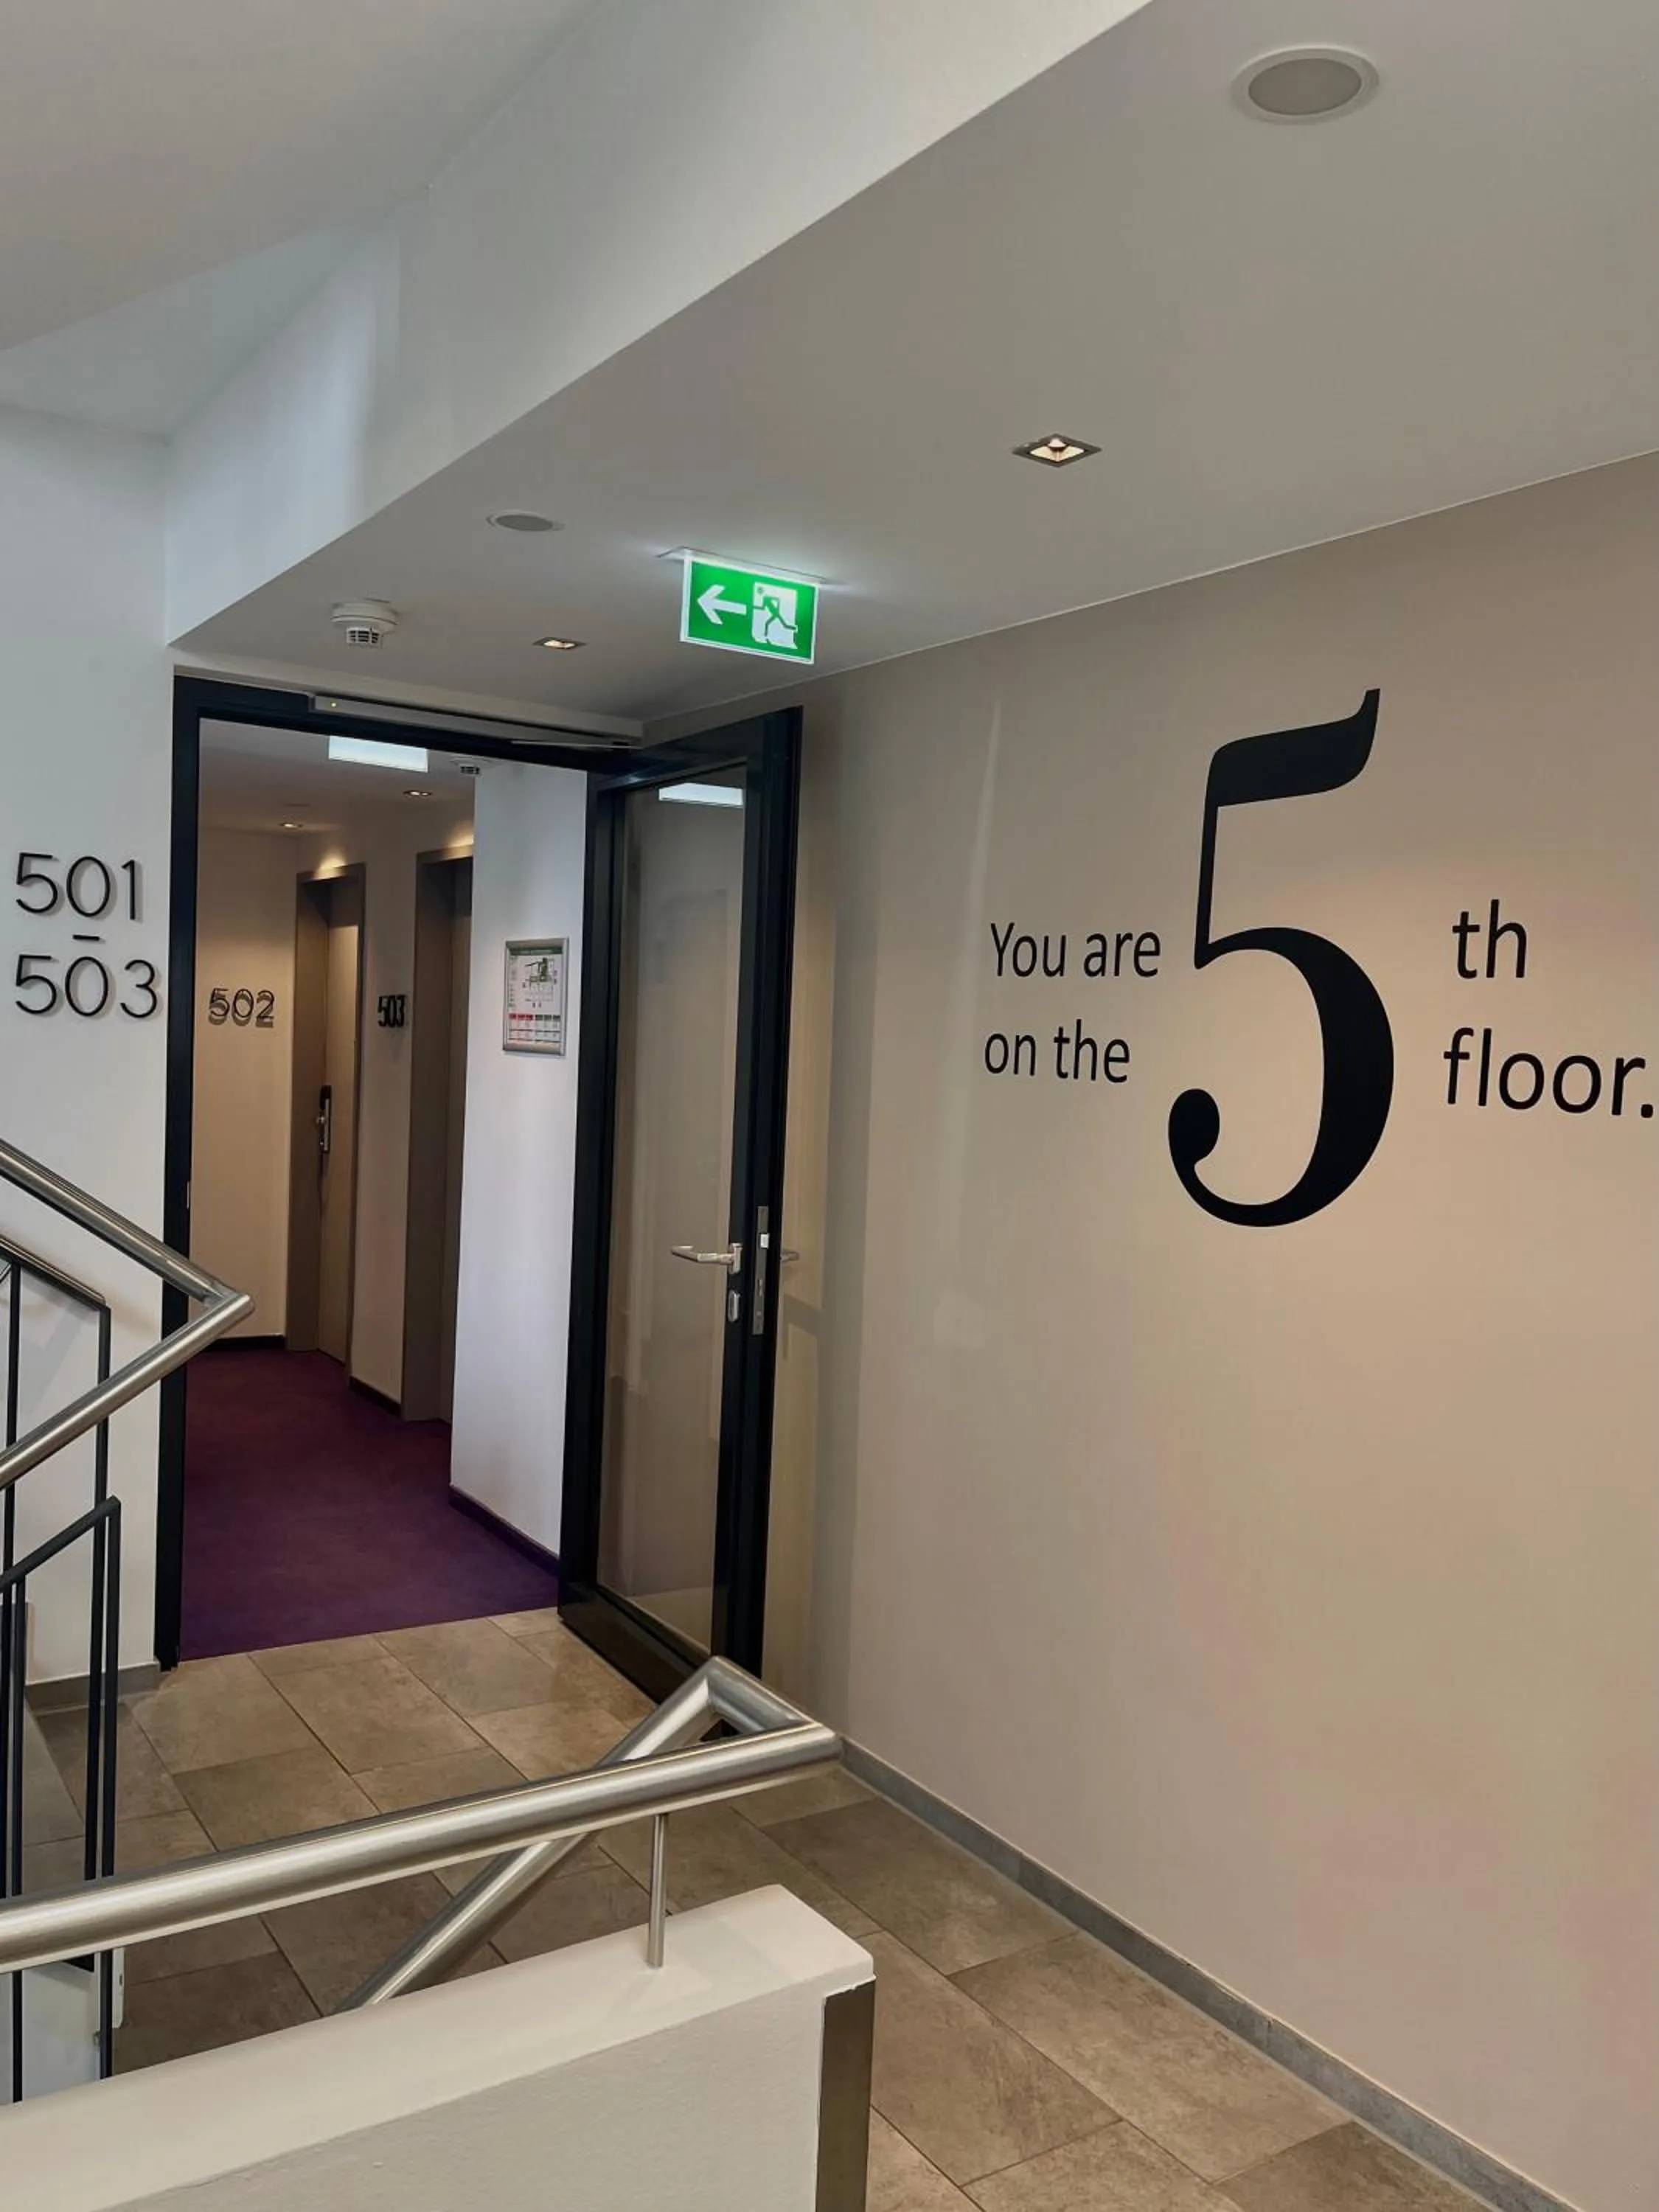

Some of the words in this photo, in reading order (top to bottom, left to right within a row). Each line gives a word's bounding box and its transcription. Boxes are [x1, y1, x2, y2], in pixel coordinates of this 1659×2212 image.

[15, 852, 136, 920] 501
[990, 922, 1066, 978] You
[1082, 932, 1161, 978] are
[1168, 688, 1394, 1228] 5
[1452, 899, 1527, 979] th
[15, 954, 158, 1019] 503
[209, 988, 276, 1023] 502
[378, 994, 407, 1029] 503
[984, 1033, 1037, 1077] on
[1053, 1018, 1130, 1083] the
[1443, 1027, 1655, 1119] floor.
